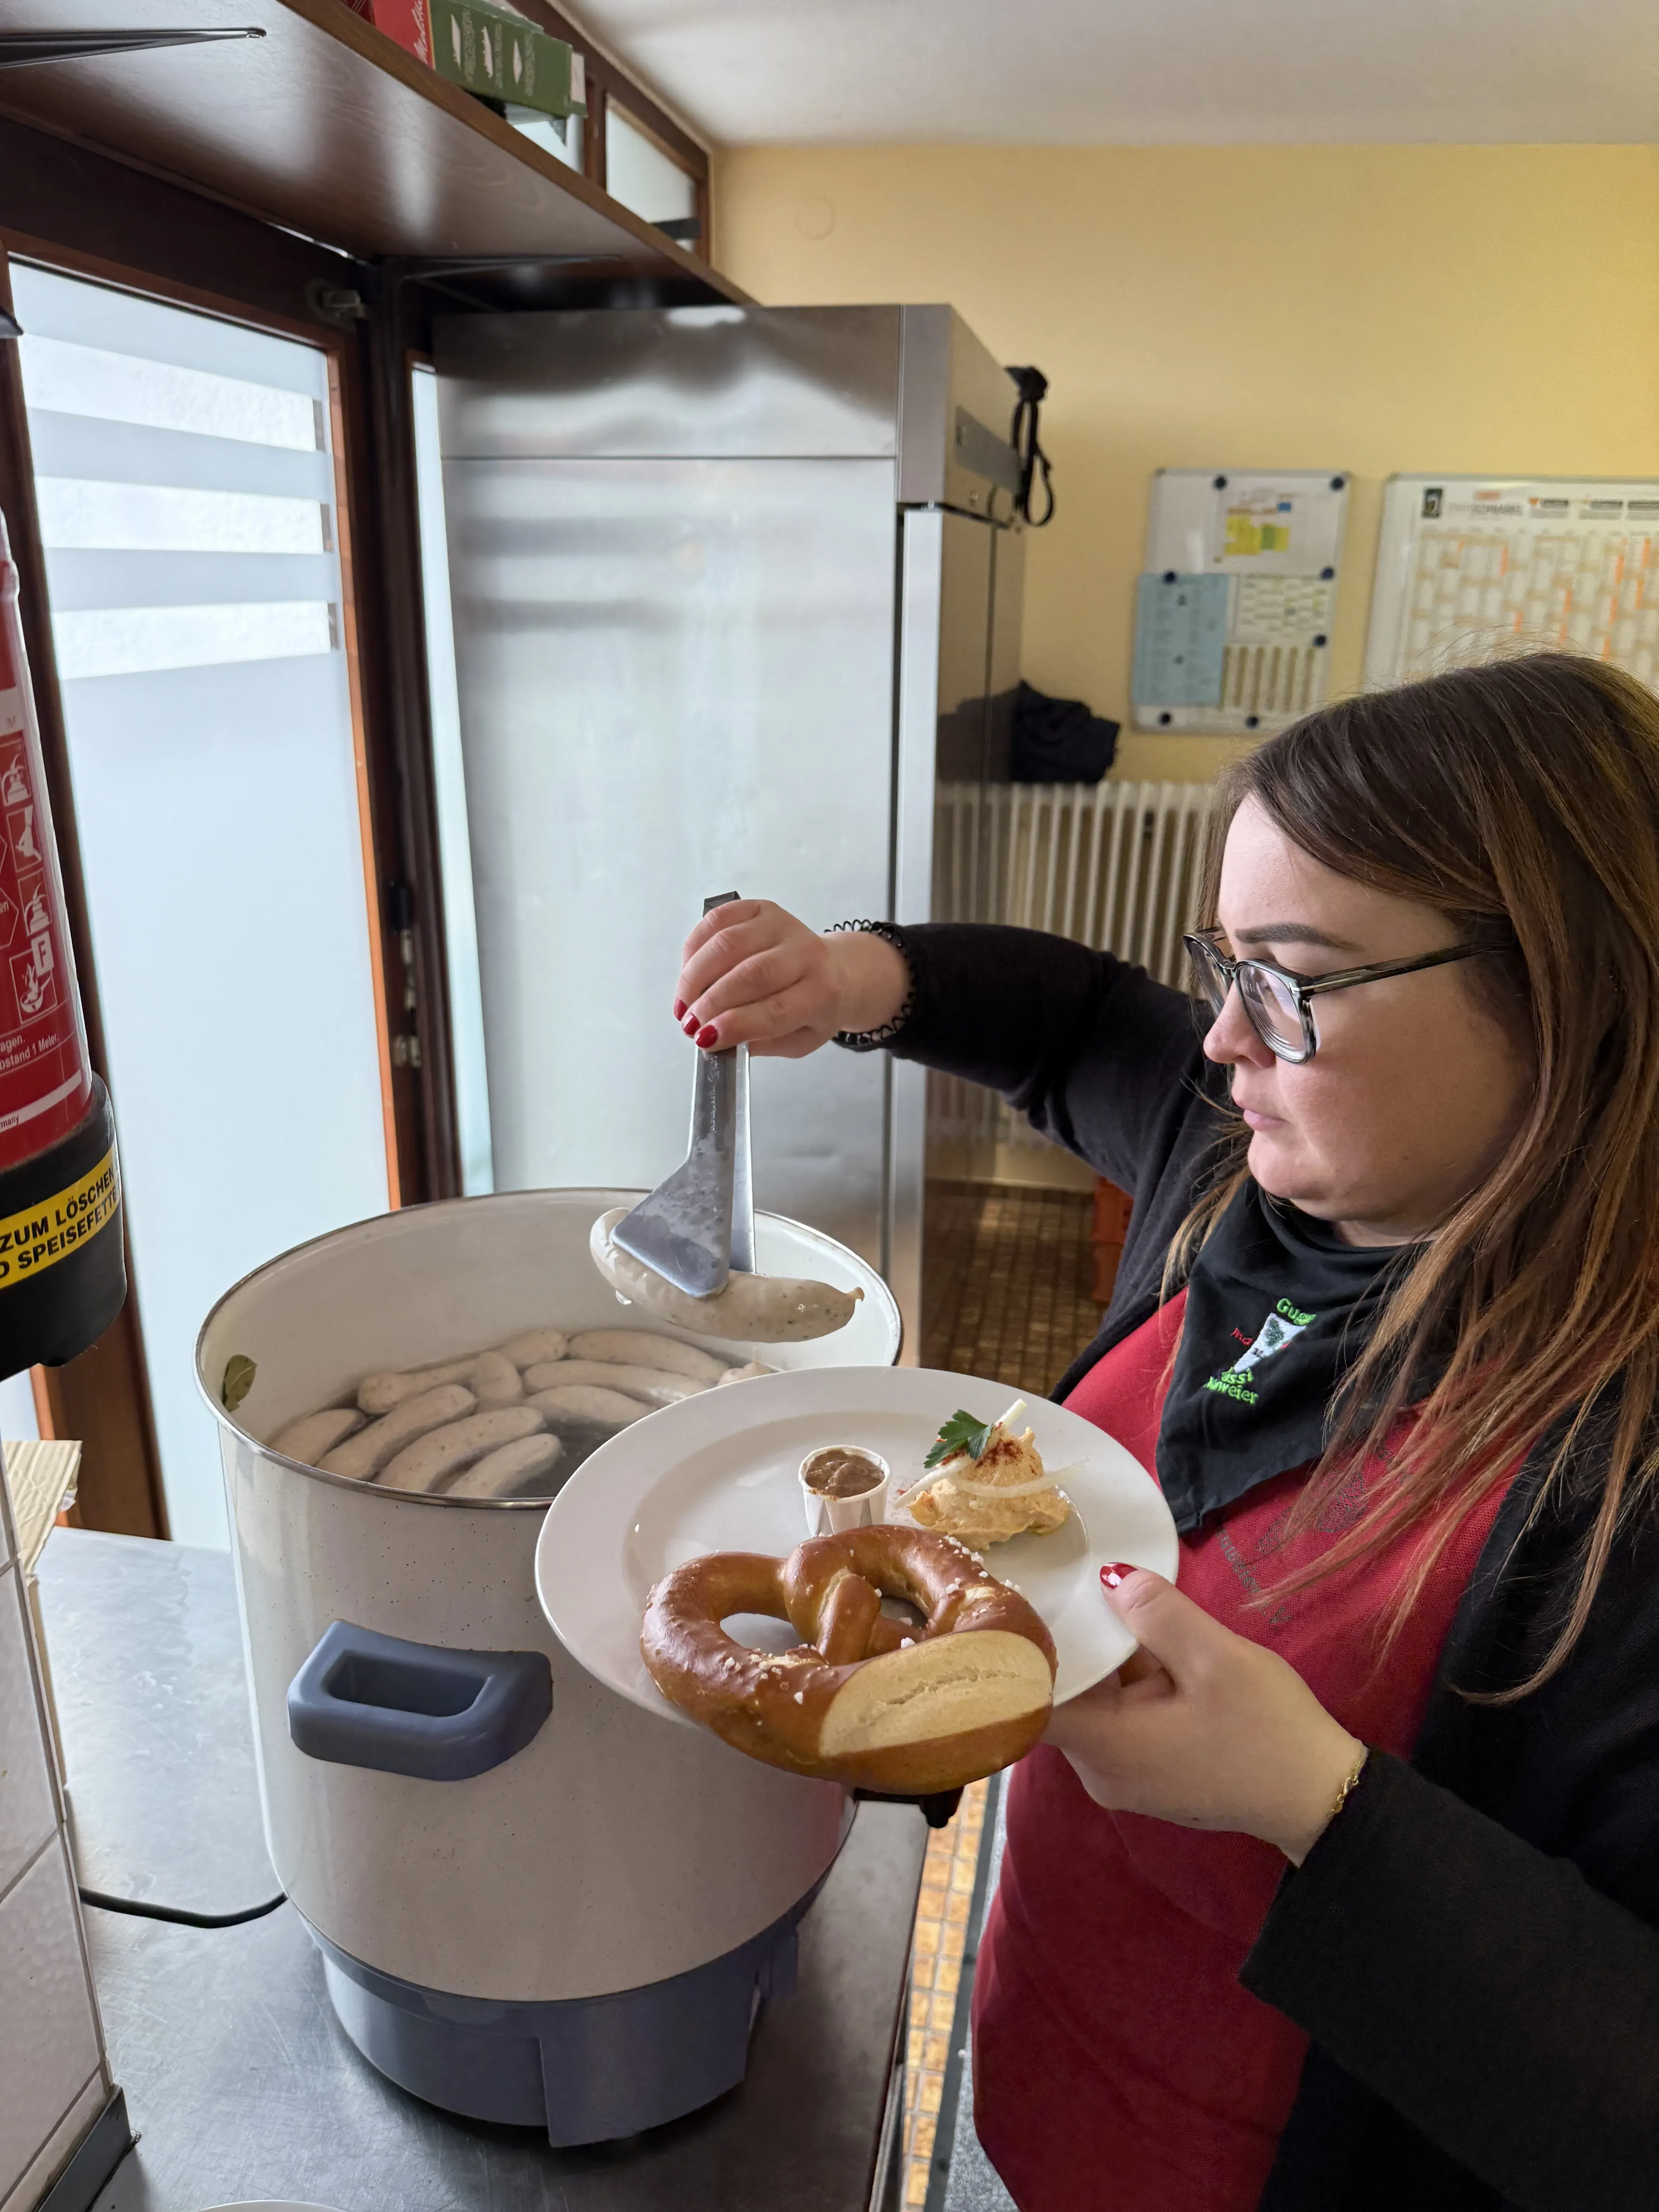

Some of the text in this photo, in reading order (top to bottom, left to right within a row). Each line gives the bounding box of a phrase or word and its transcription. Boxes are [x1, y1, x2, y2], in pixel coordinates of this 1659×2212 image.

[38, 939, 46, 968] F
[32, 1042, 36, 1055] 1
[0, 1164, 114, 1254] ZUM LÖSCHEN
